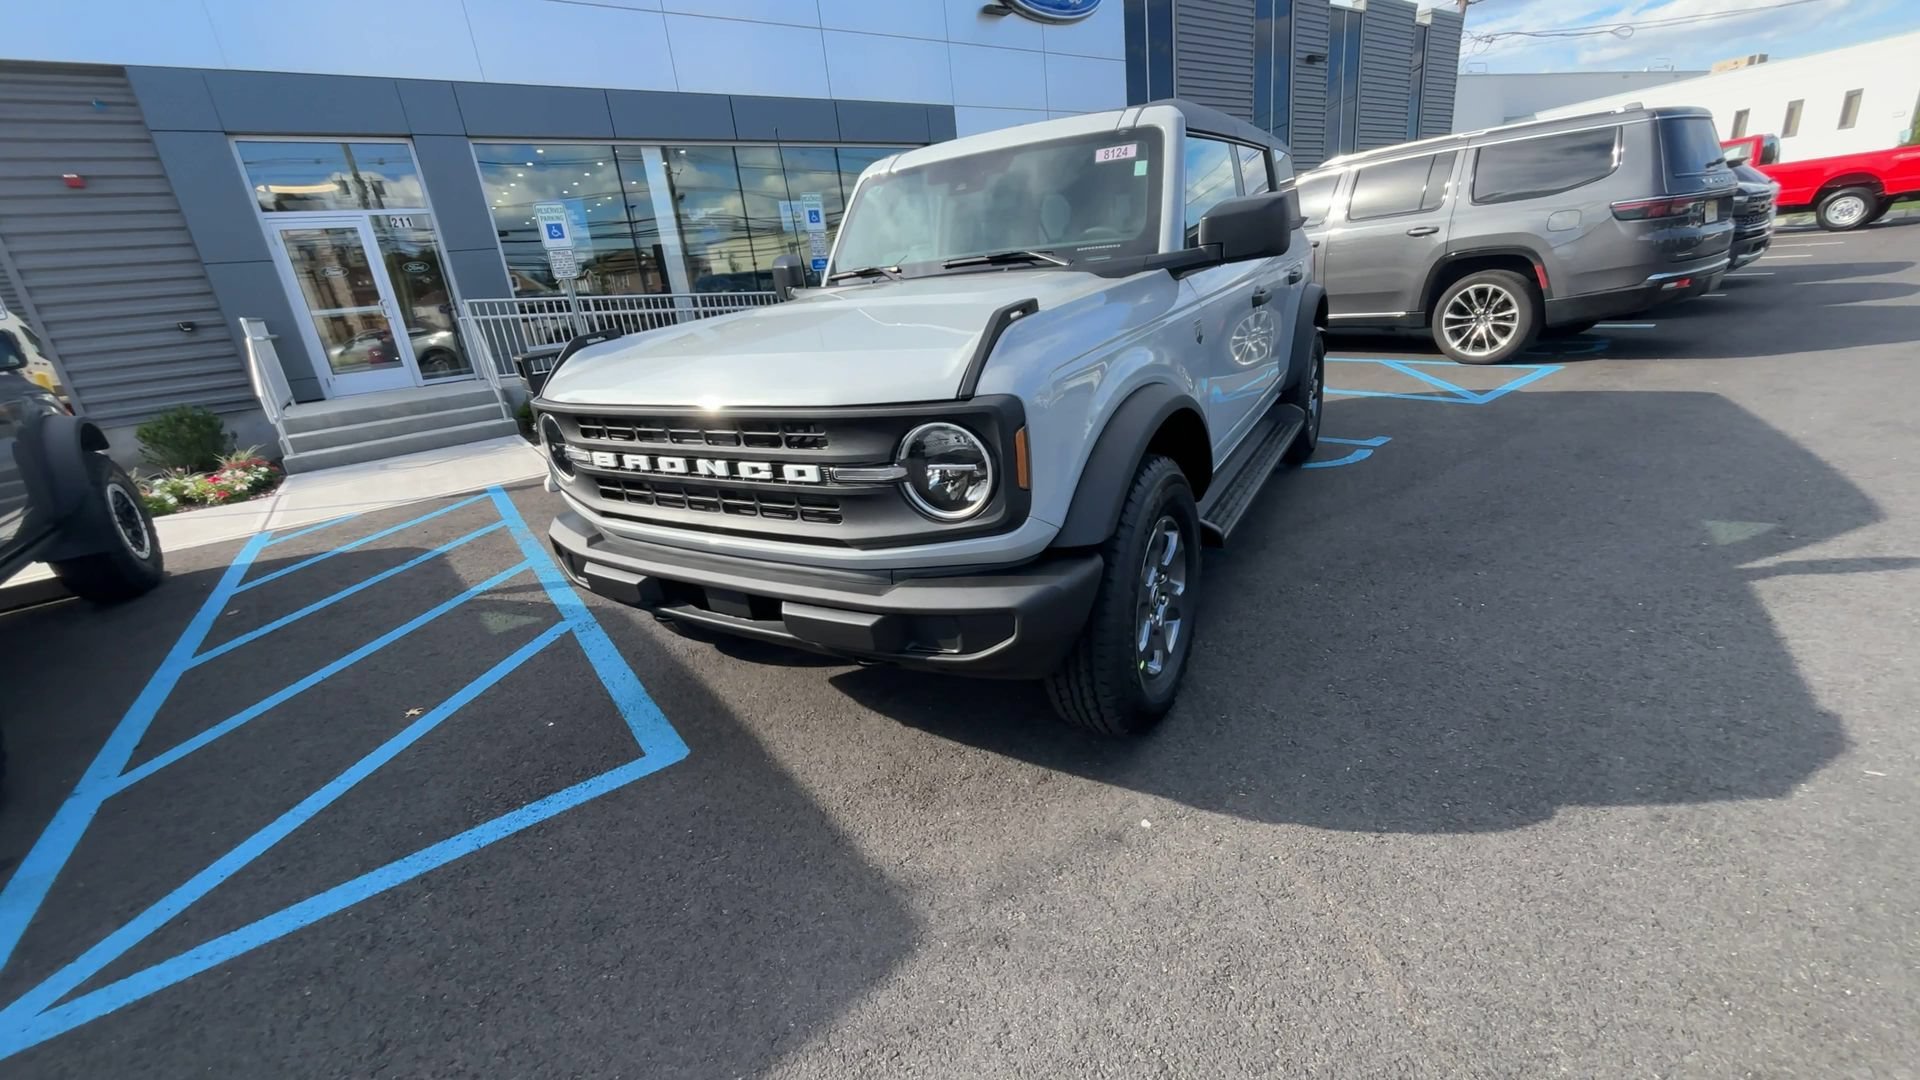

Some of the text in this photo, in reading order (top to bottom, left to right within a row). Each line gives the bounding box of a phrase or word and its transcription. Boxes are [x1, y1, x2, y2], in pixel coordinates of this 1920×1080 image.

[1103, 146, 1128, 160] 8124
[391, 217, 413, 228] 211
[592, 451, 821, 483] BRONCO
